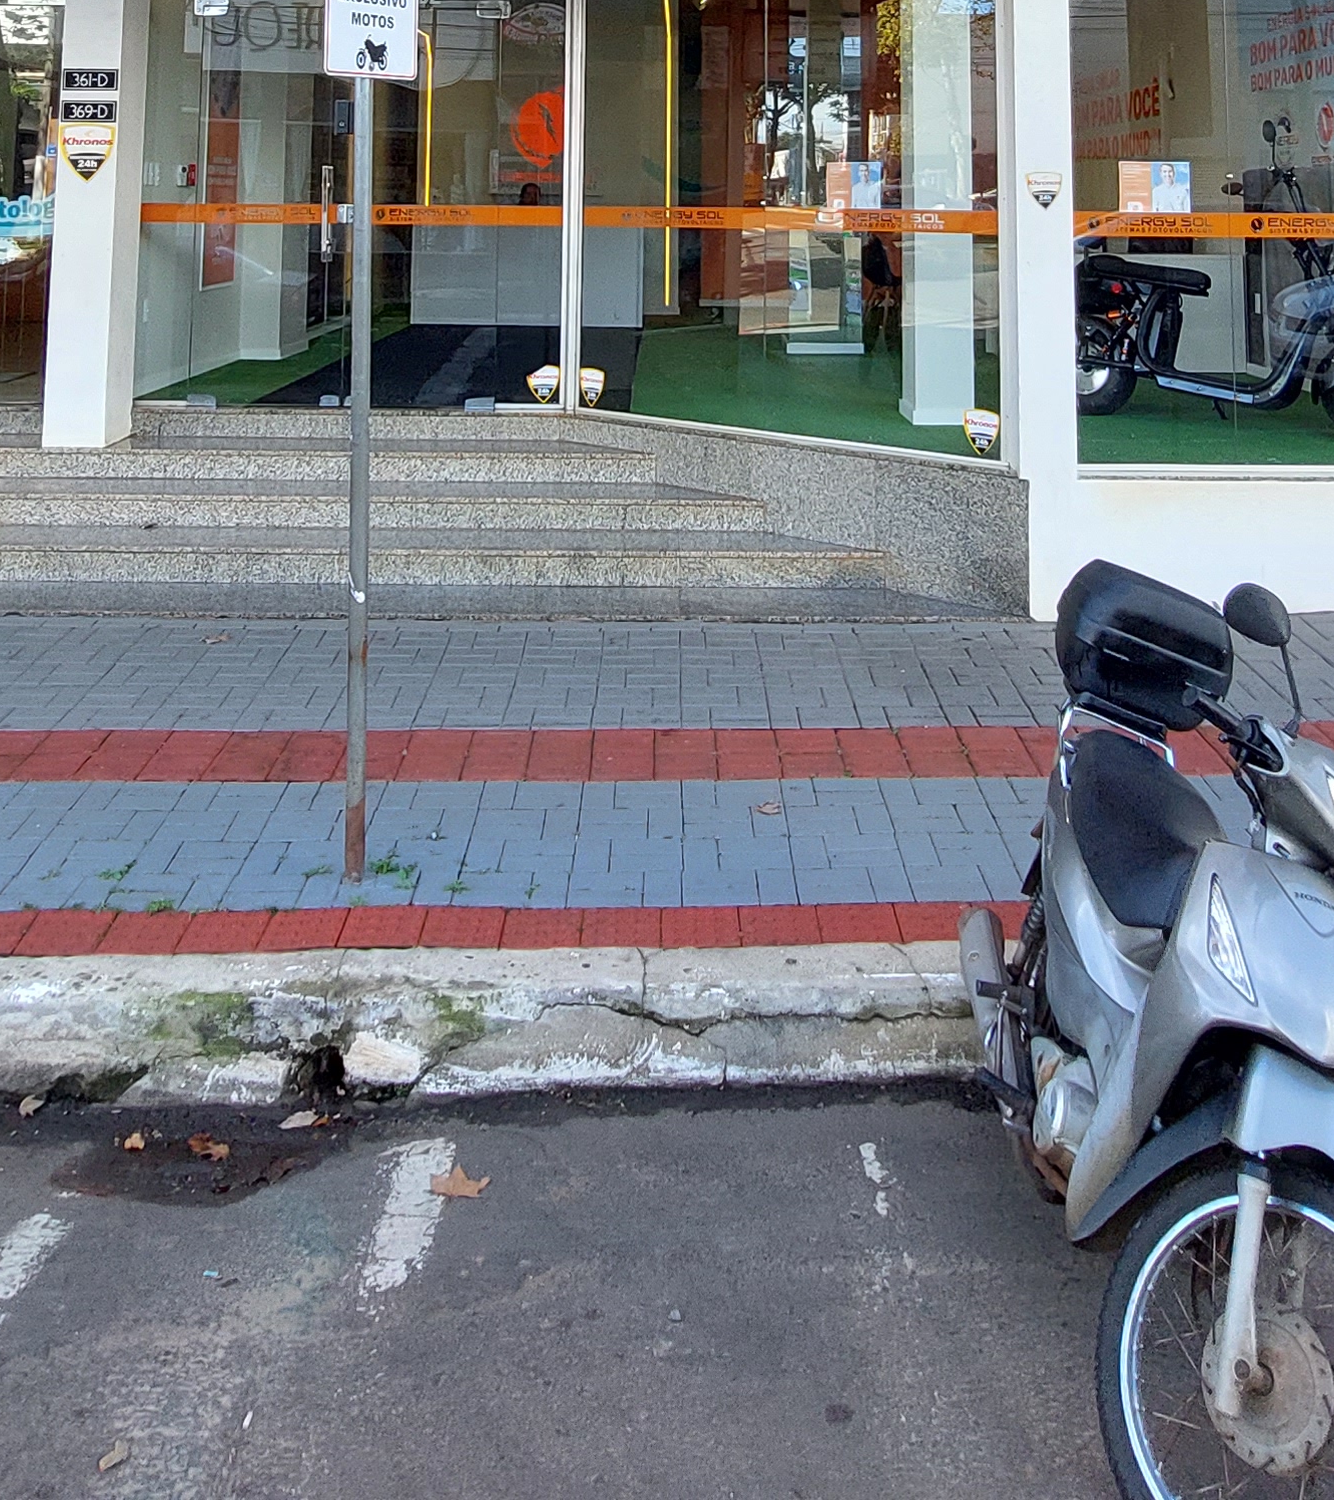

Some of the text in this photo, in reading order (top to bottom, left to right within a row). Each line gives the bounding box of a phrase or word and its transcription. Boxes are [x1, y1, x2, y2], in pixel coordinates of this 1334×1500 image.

[351, 12, 394, 29] MOTOS
[1250, 38, 1276, 66] BOM
[1280, 26, 1317, 56] PARA
[72, 73, 109, 87] 361-D
[1250, 70, 1272, 93] BOM
[1274, 64, 1303, 88] PARA
[1305, 61, 1313, 81] O
[69, 104, 108, 118] 369-D
[62, 137, 114, 146] Khronos
[77, 160, 97, 168] 24h
[389, 208, 445, 217] ENERGY
[696, 211, 724, 220] SOL
[909, 213, 944, 223] SOL
[1105, 217, 1213, 227] ENERGY SOL
